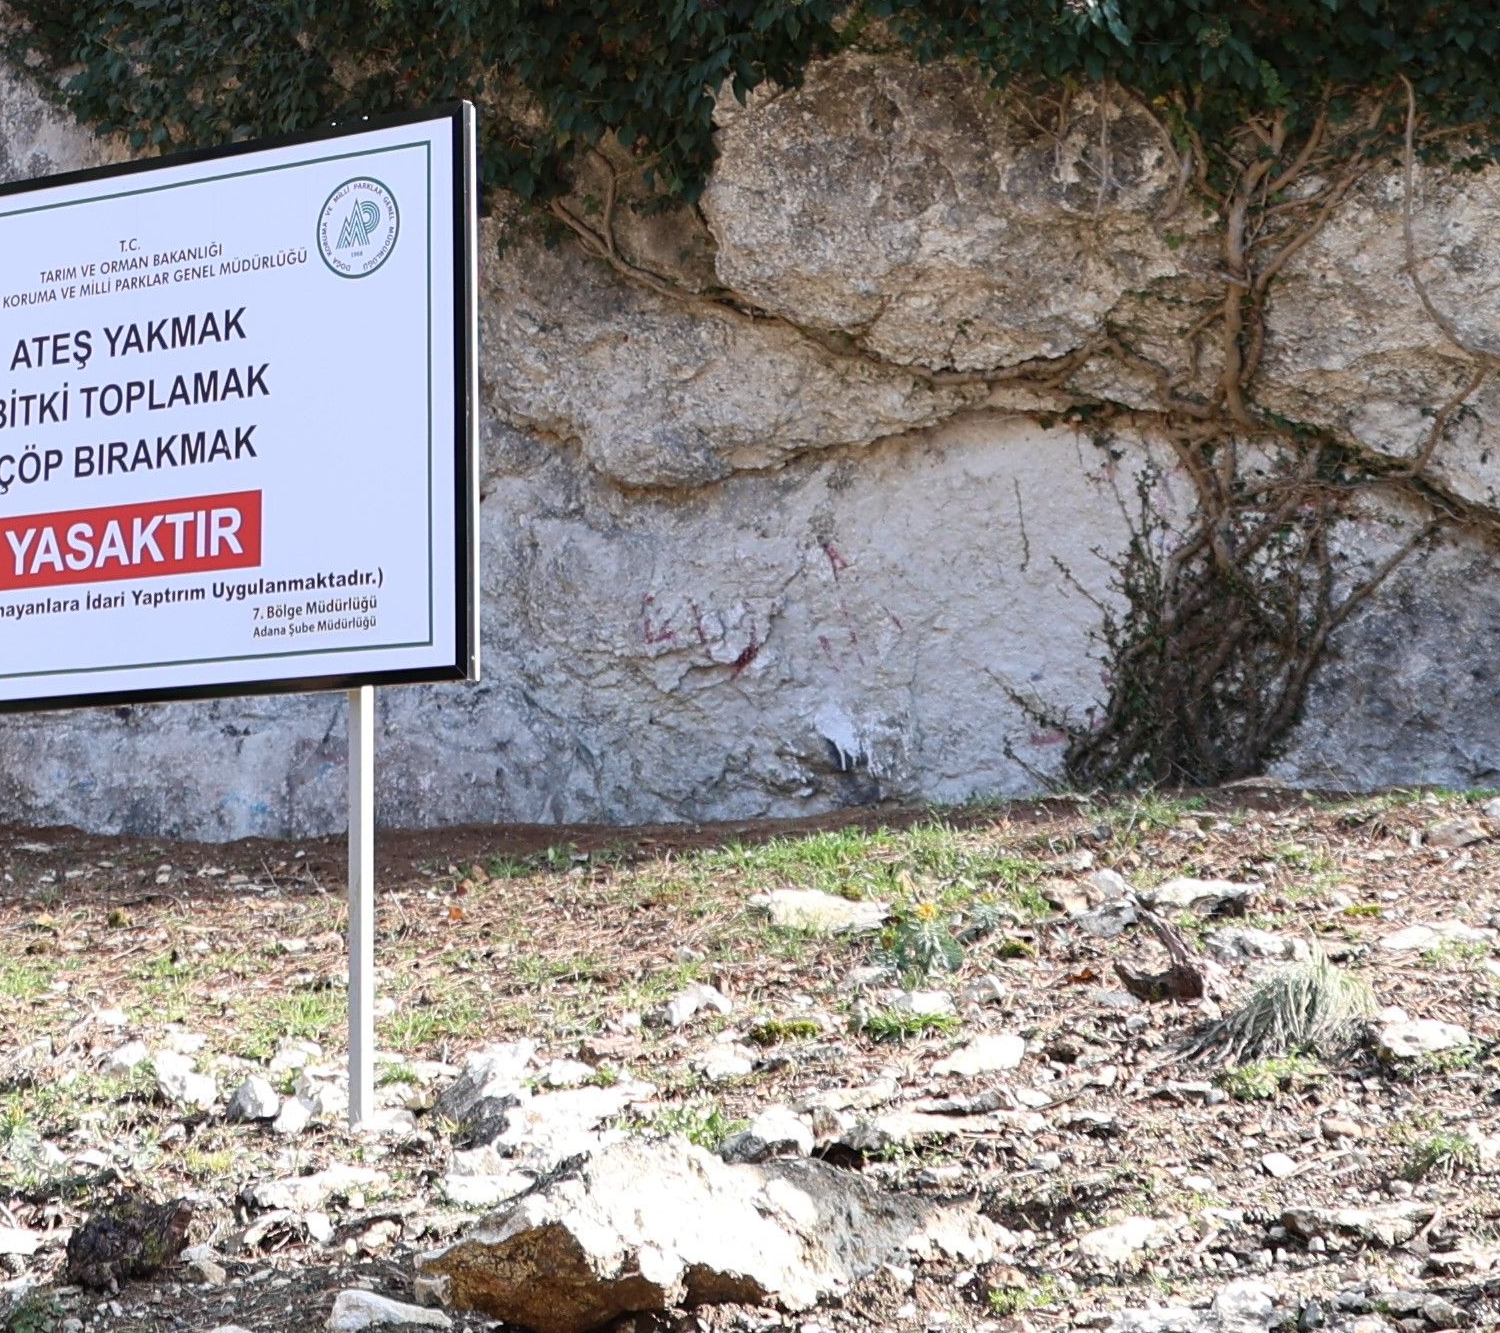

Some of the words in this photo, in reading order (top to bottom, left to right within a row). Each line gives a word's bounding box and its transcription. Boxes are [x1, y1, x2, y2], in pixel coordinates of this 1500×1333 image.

[325, 206, 333, 216] VE
[353, 182, 383, 196] PARKLAR
[383, 196, 395, 221] GENEL
[40, 267, 77, 284] TARIM
[81, 264, 96, 278] VE
[100, 256, 148, 275] ORMAN
[153, 242, 223, 267] BAKANLIĞI
[119, 238, 141, 253] T.C.
[3, 287, 57, 309] KORUMA
[61, 284, 75, 299] VE
[80, 277, 111, 297] MİLLİ
[115, 273, 169, 293] PARKLAR
[174, 266, 215, 283] GENEL
[219, 247, 308, 276] MÜDÜRLÜĞÜ
[10, 330, 92, 371] ATEŞ
[103, 307, 247, 357] YAKMAK
[80, 363, 270, 418] TOPLAMAK
[74, 425, 257, 478] BIRAKMAK
[5, 507, 243, 576] YASAKTIR
[86, 590, 125, 611] İdari
[131, 585, 205, 608] Yaptırım
[212, 566, 384, 601] Uygulanmaktadır.)
[253, 607, 264, 620] 7.
[267, 603, 302, 620] Bölge
[306, 595, 377, 615] Müdürlüğü
[253, 626, 286, 638] Adana
[289, 621, 315, 637] Şube
[317, 616, 377, 632] Müdürlüğü
